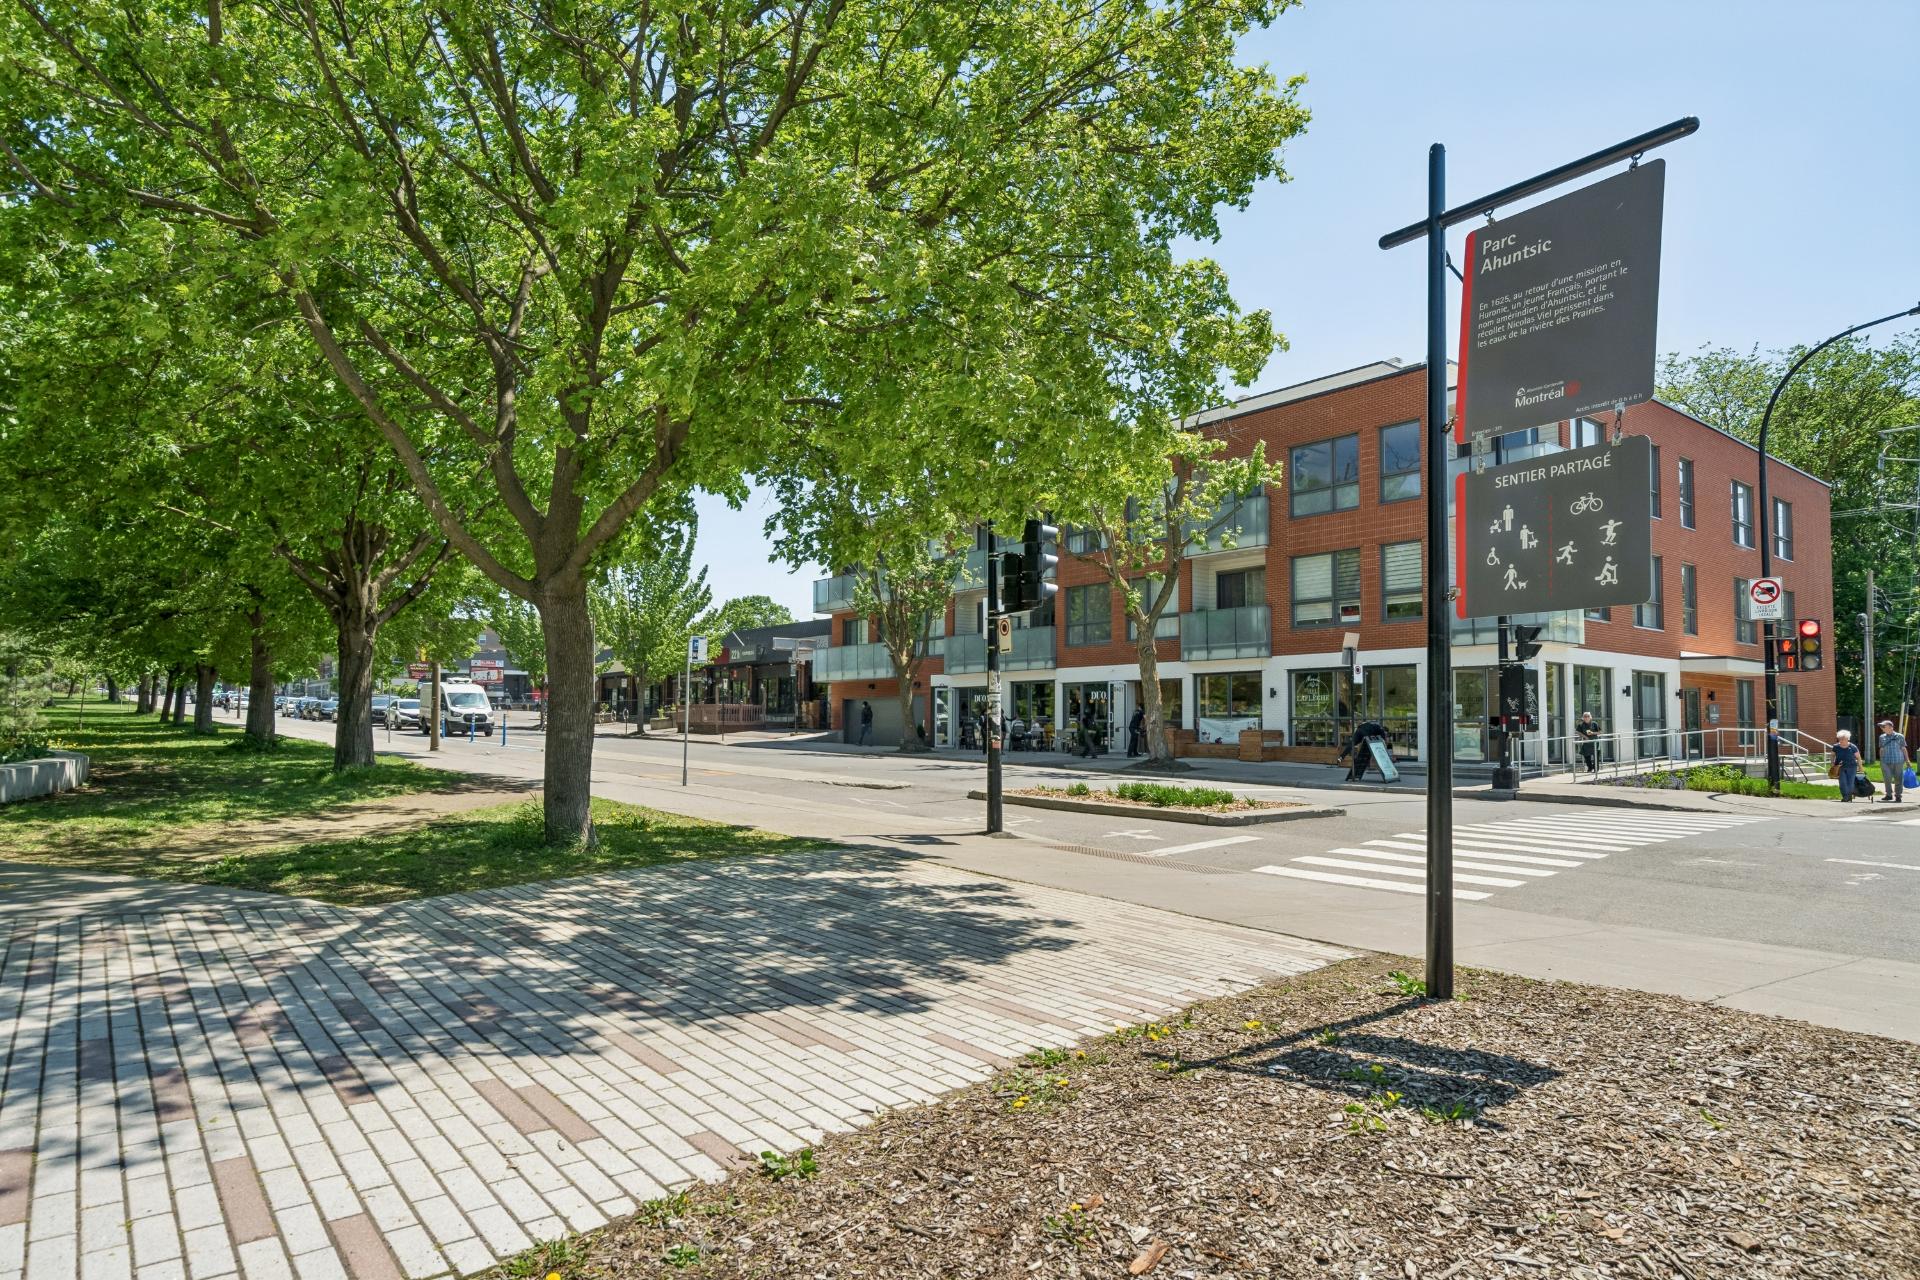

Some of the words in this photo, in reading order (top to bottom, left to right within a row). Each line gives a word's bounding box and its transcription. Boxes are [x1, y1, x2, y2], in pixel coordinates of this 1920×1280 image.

[1480, 239, 1552, 274] Ahuntsic
[1482, 234, 1517, 256] Parc
[1478, 320, 1494, 330] nom
[1496, 305, 1539, 324] amérindien
[1540, 290, 1586, 310] d'Ahuntsic,
[1588, 286, 1596, 295] et
[1599, 283, 1607, 292] le
[1479, 302, 1489, 311] En
[1491, 295, 1511, 307] 1625,
[1513, 291, 1523, 300] au
[1525, 282, 1549, 296] retour
[1551, 274, 1574, 288] d'une
[1576, 263, 1608, 280] mission
[1610, 259, 1621, 268] en
[1479, 305, 1510, 320] Huronie,
[1511, 301, 1522, 310] un
[1523, 294, 1545, 309] jeune
[1547, 281, 1583, 298] Français,
[1585, 270, 1617, 288] portant
[1620, 266, 1628, 276] le
[1477, 325, 1505, 339] récollet
[1507, 316, 1535, 330] Nicolas
[1536, 309, 1552, 320] Viel
[1554, 298, 1591, 318] périssent
[1593, 291, 1614, 304] dans
[1477, 340, 1488, 349] les
[1489, 334, 1507, 345] eaux
[1508, 330, 1518, 339] de
[1520, 327, 1527, 335] la
[1529, 320, 1554, 333] rivière
[1556, 315, 1571, 325] des
[1572, 305, 1606, 320] Prairies.
[1515, 386, 1564, 408] Montréal
[1495, 467, 1547, 489] SENTIER
[1550, 450, 1611, 478] PARTAGÉ
